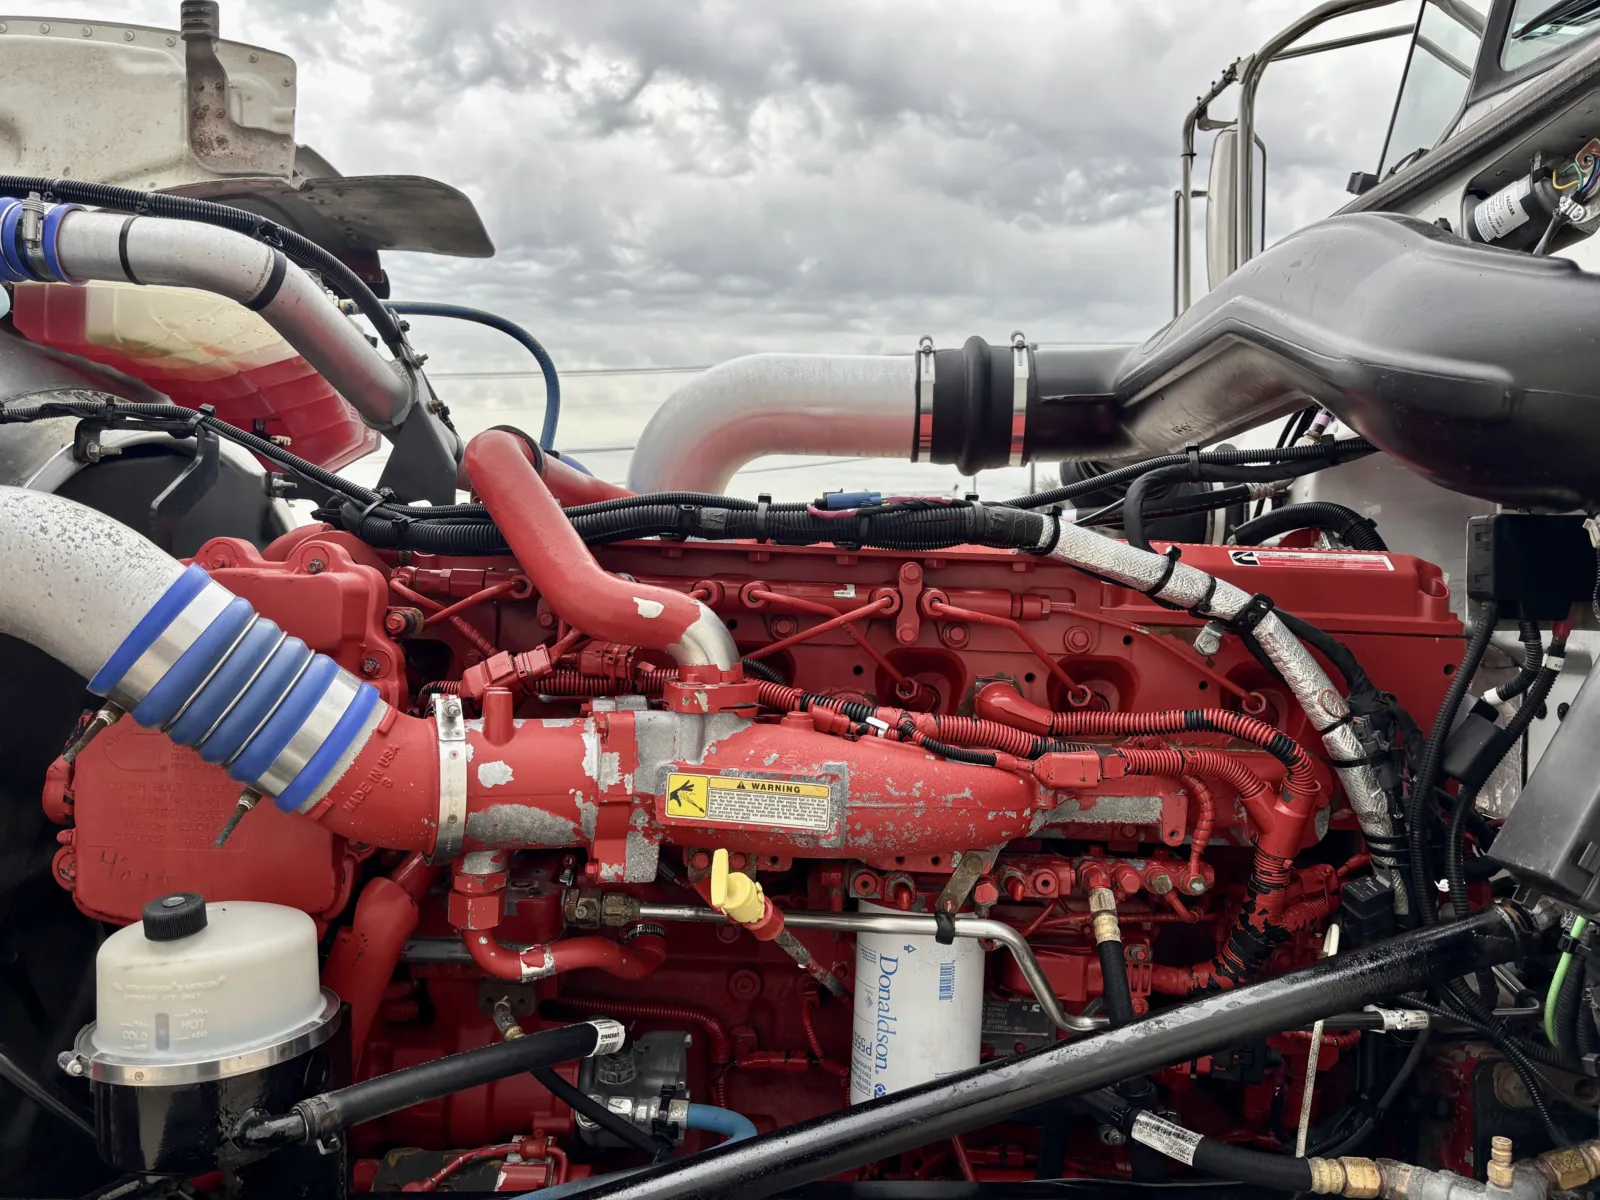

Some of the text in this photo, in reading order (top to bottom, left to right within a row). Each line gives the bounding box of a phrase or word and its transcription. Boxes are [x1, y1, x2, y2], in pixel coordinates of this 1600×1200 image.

[342, 744, 400, 812] MADE IN USA
[752, 783, 801, 793] WARNING
[876, 954, 898, 1071] Donaldson
[181, 1018, 206, 1030] HOT
[122, 1030, 148, 1041] COLD
[190, 1030, 208, 1039] ADD
